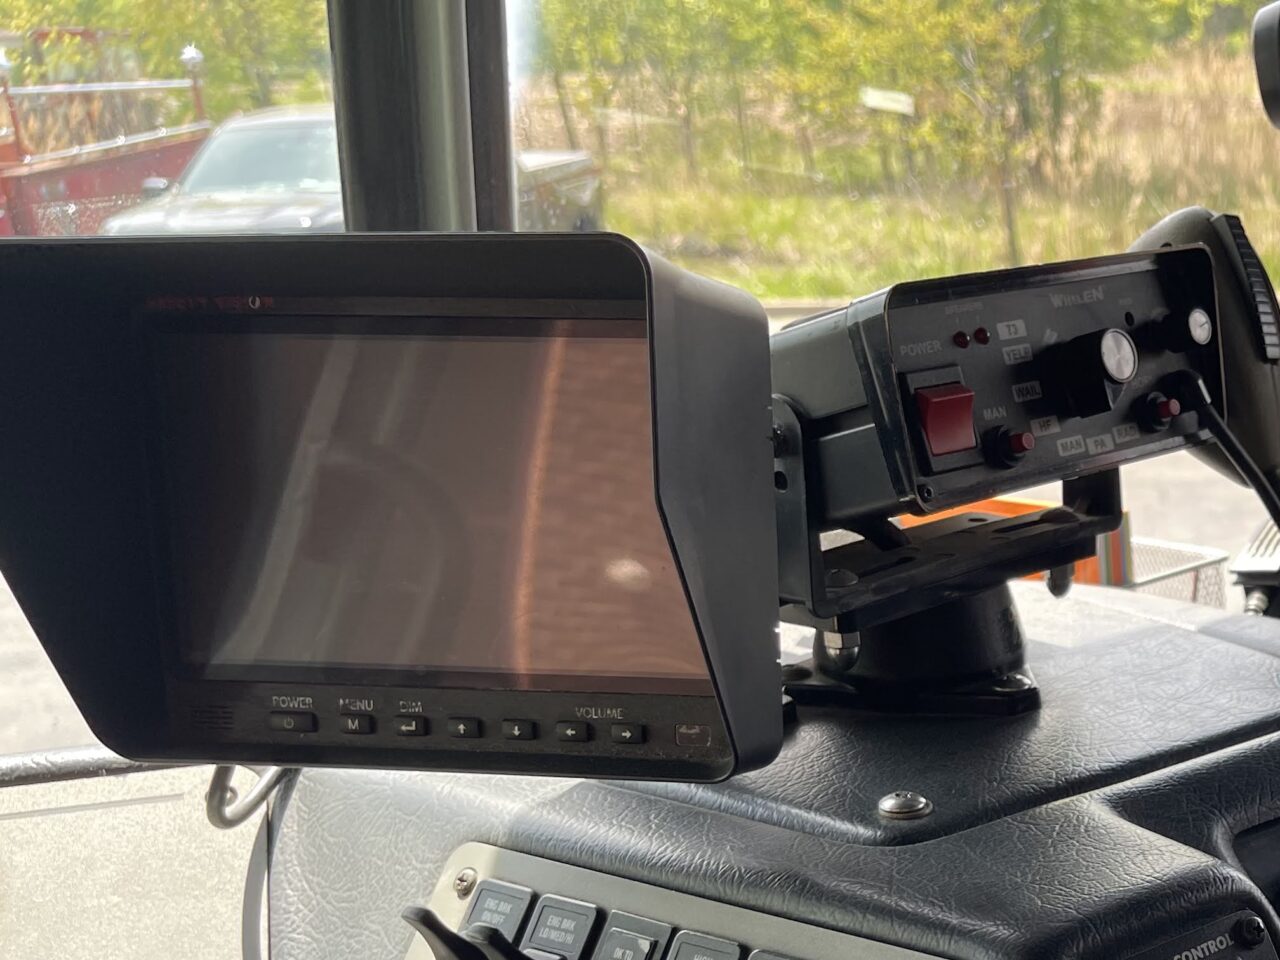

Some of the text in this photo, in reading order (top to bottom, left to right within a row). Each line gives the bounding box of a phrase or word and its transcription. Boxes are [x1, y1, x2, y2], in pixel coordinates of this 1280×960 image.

[900, 339, 943, 359] POWER
[1006, 346, 1031, 362] YELP
[1016, 383, 1041, 399] WAIL
[983, 405, 1007, 422] MAN
[1039, 421, 1052, 433] HF
[1060, 438, 1082, 453] MAN
[271, 695, 313, 709] POWER
[338, 697, 375, 712] MENU
[399, 700, 423, 713] DIM
[574, 706, 624, 720] VOLUME
[484, 897, 512, 914] ENG BRK
[546, 914, 577, 931] ENG BRK
[538, 926, 575, 945] LO/MED/HI
[613, 947, 624, 959] OK
